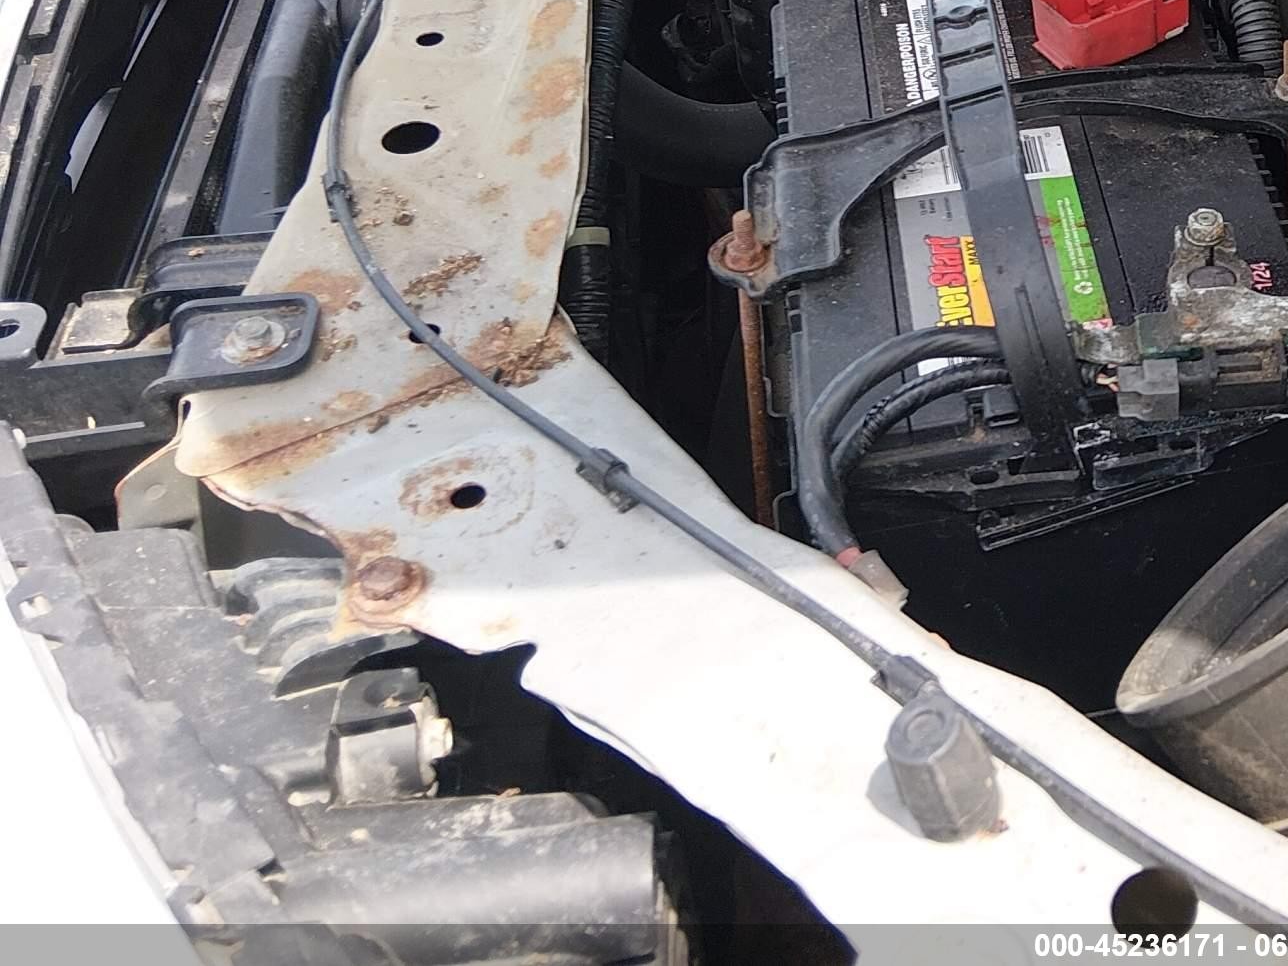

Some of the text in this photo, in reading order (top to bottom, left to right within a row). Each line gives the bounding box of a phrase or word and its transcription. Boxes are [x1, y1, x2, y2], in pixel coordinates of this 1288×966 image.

[895, 22, 921, 100] DANGER/POISON
[965, 240, 980, 265] MAXX
[1250, 262, 1273, 290] 1/24
